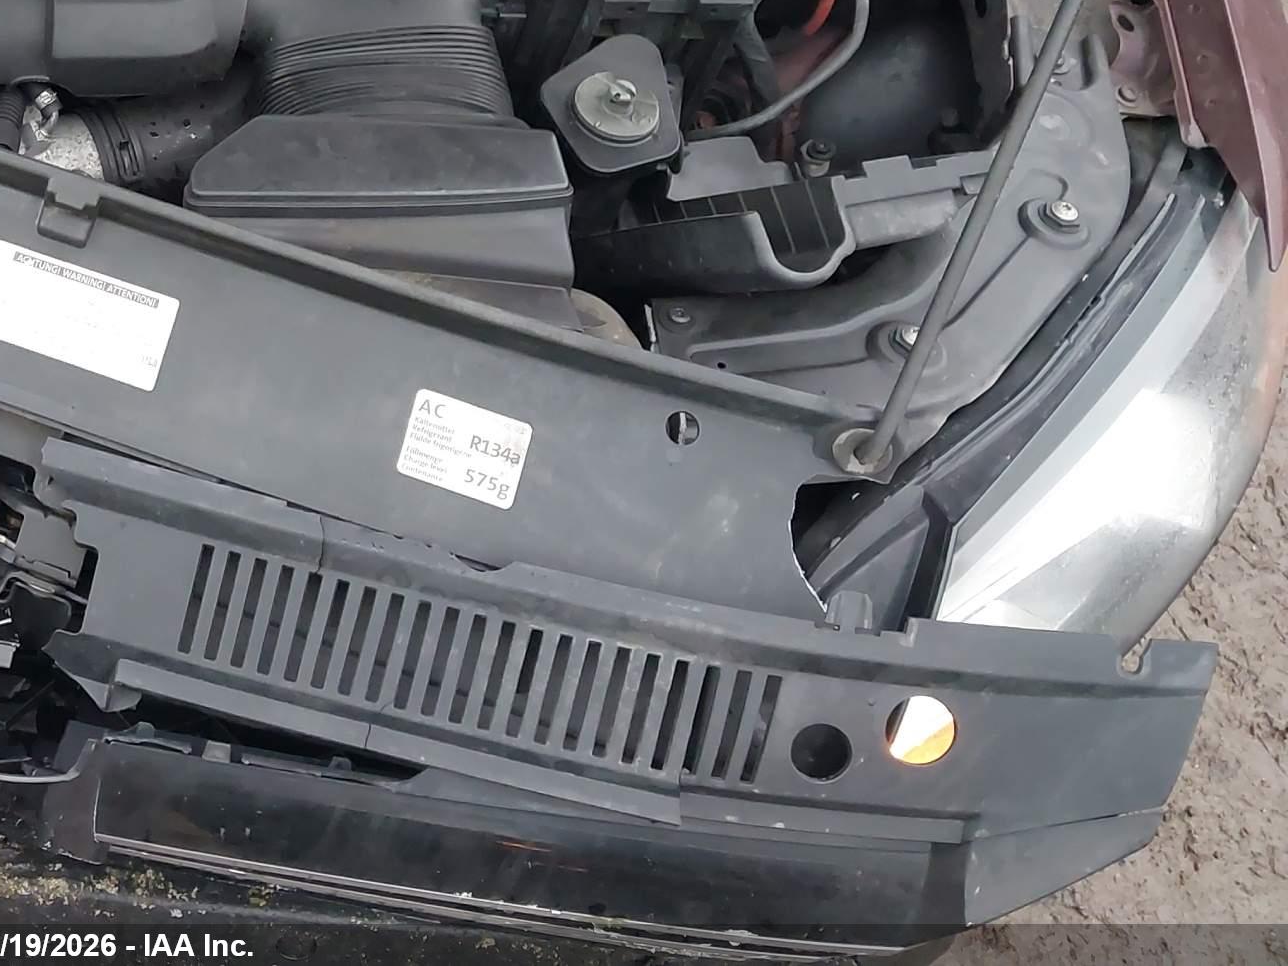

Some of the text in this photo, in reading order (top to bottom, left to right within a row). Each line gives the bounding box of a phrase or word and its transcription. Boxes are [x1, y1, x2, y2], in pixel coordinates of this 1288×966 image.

[62, 268, 106, 291] WARNING!
[106, 284, 158, 308] ATTENTION!
[470, 434, 521, 465] R134a
[464, 468, 510, 500] 575g
